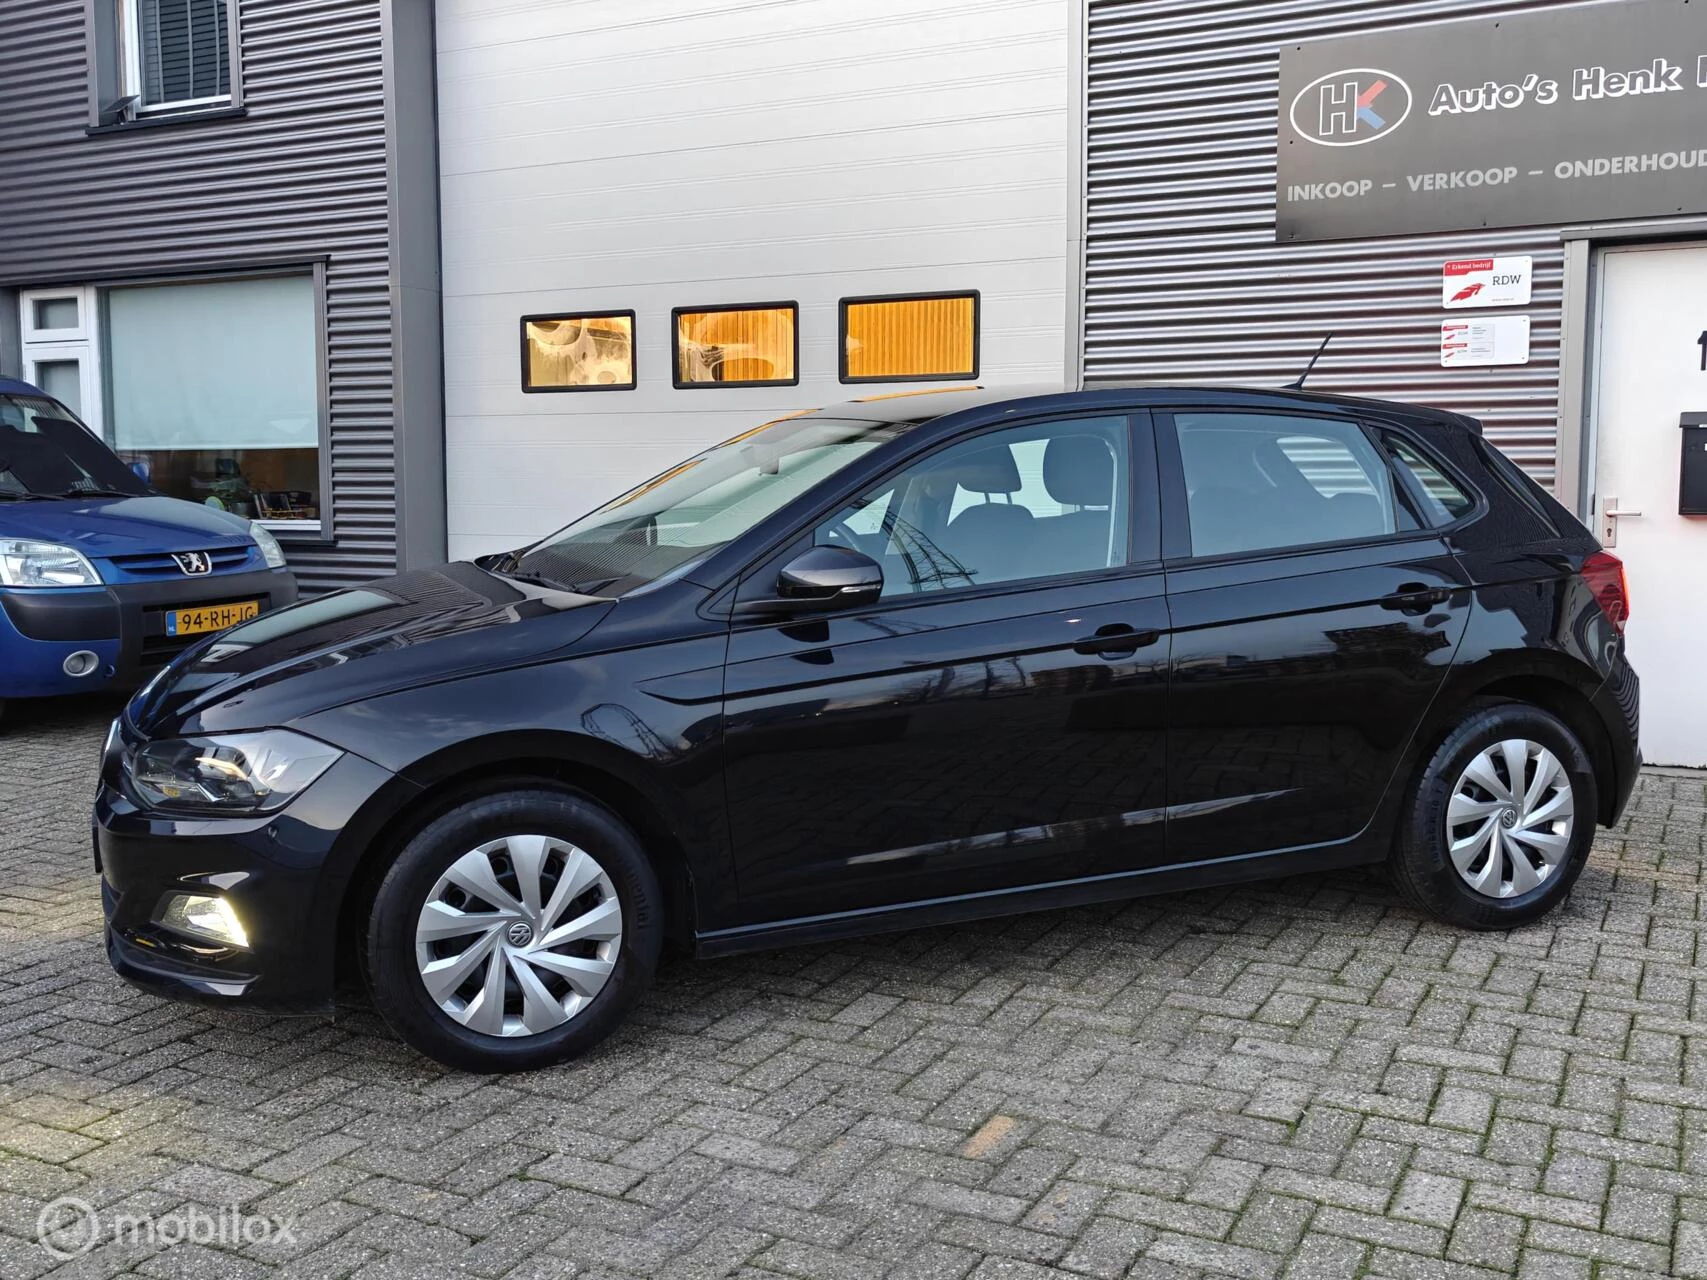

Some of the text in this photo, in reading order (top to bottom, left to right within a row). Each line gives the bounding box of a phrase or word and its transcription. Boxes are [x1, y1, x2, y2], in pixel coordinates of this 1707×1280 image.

[1428, 74, 1558, 115] Auto's
[1572, 58, 1683, 100] Henk
[1287, 180, 1373, 201] INKOOP
[1406, 166, 1518, 192] VERKOOP
[1492, 275, 1521, 286] RDW
